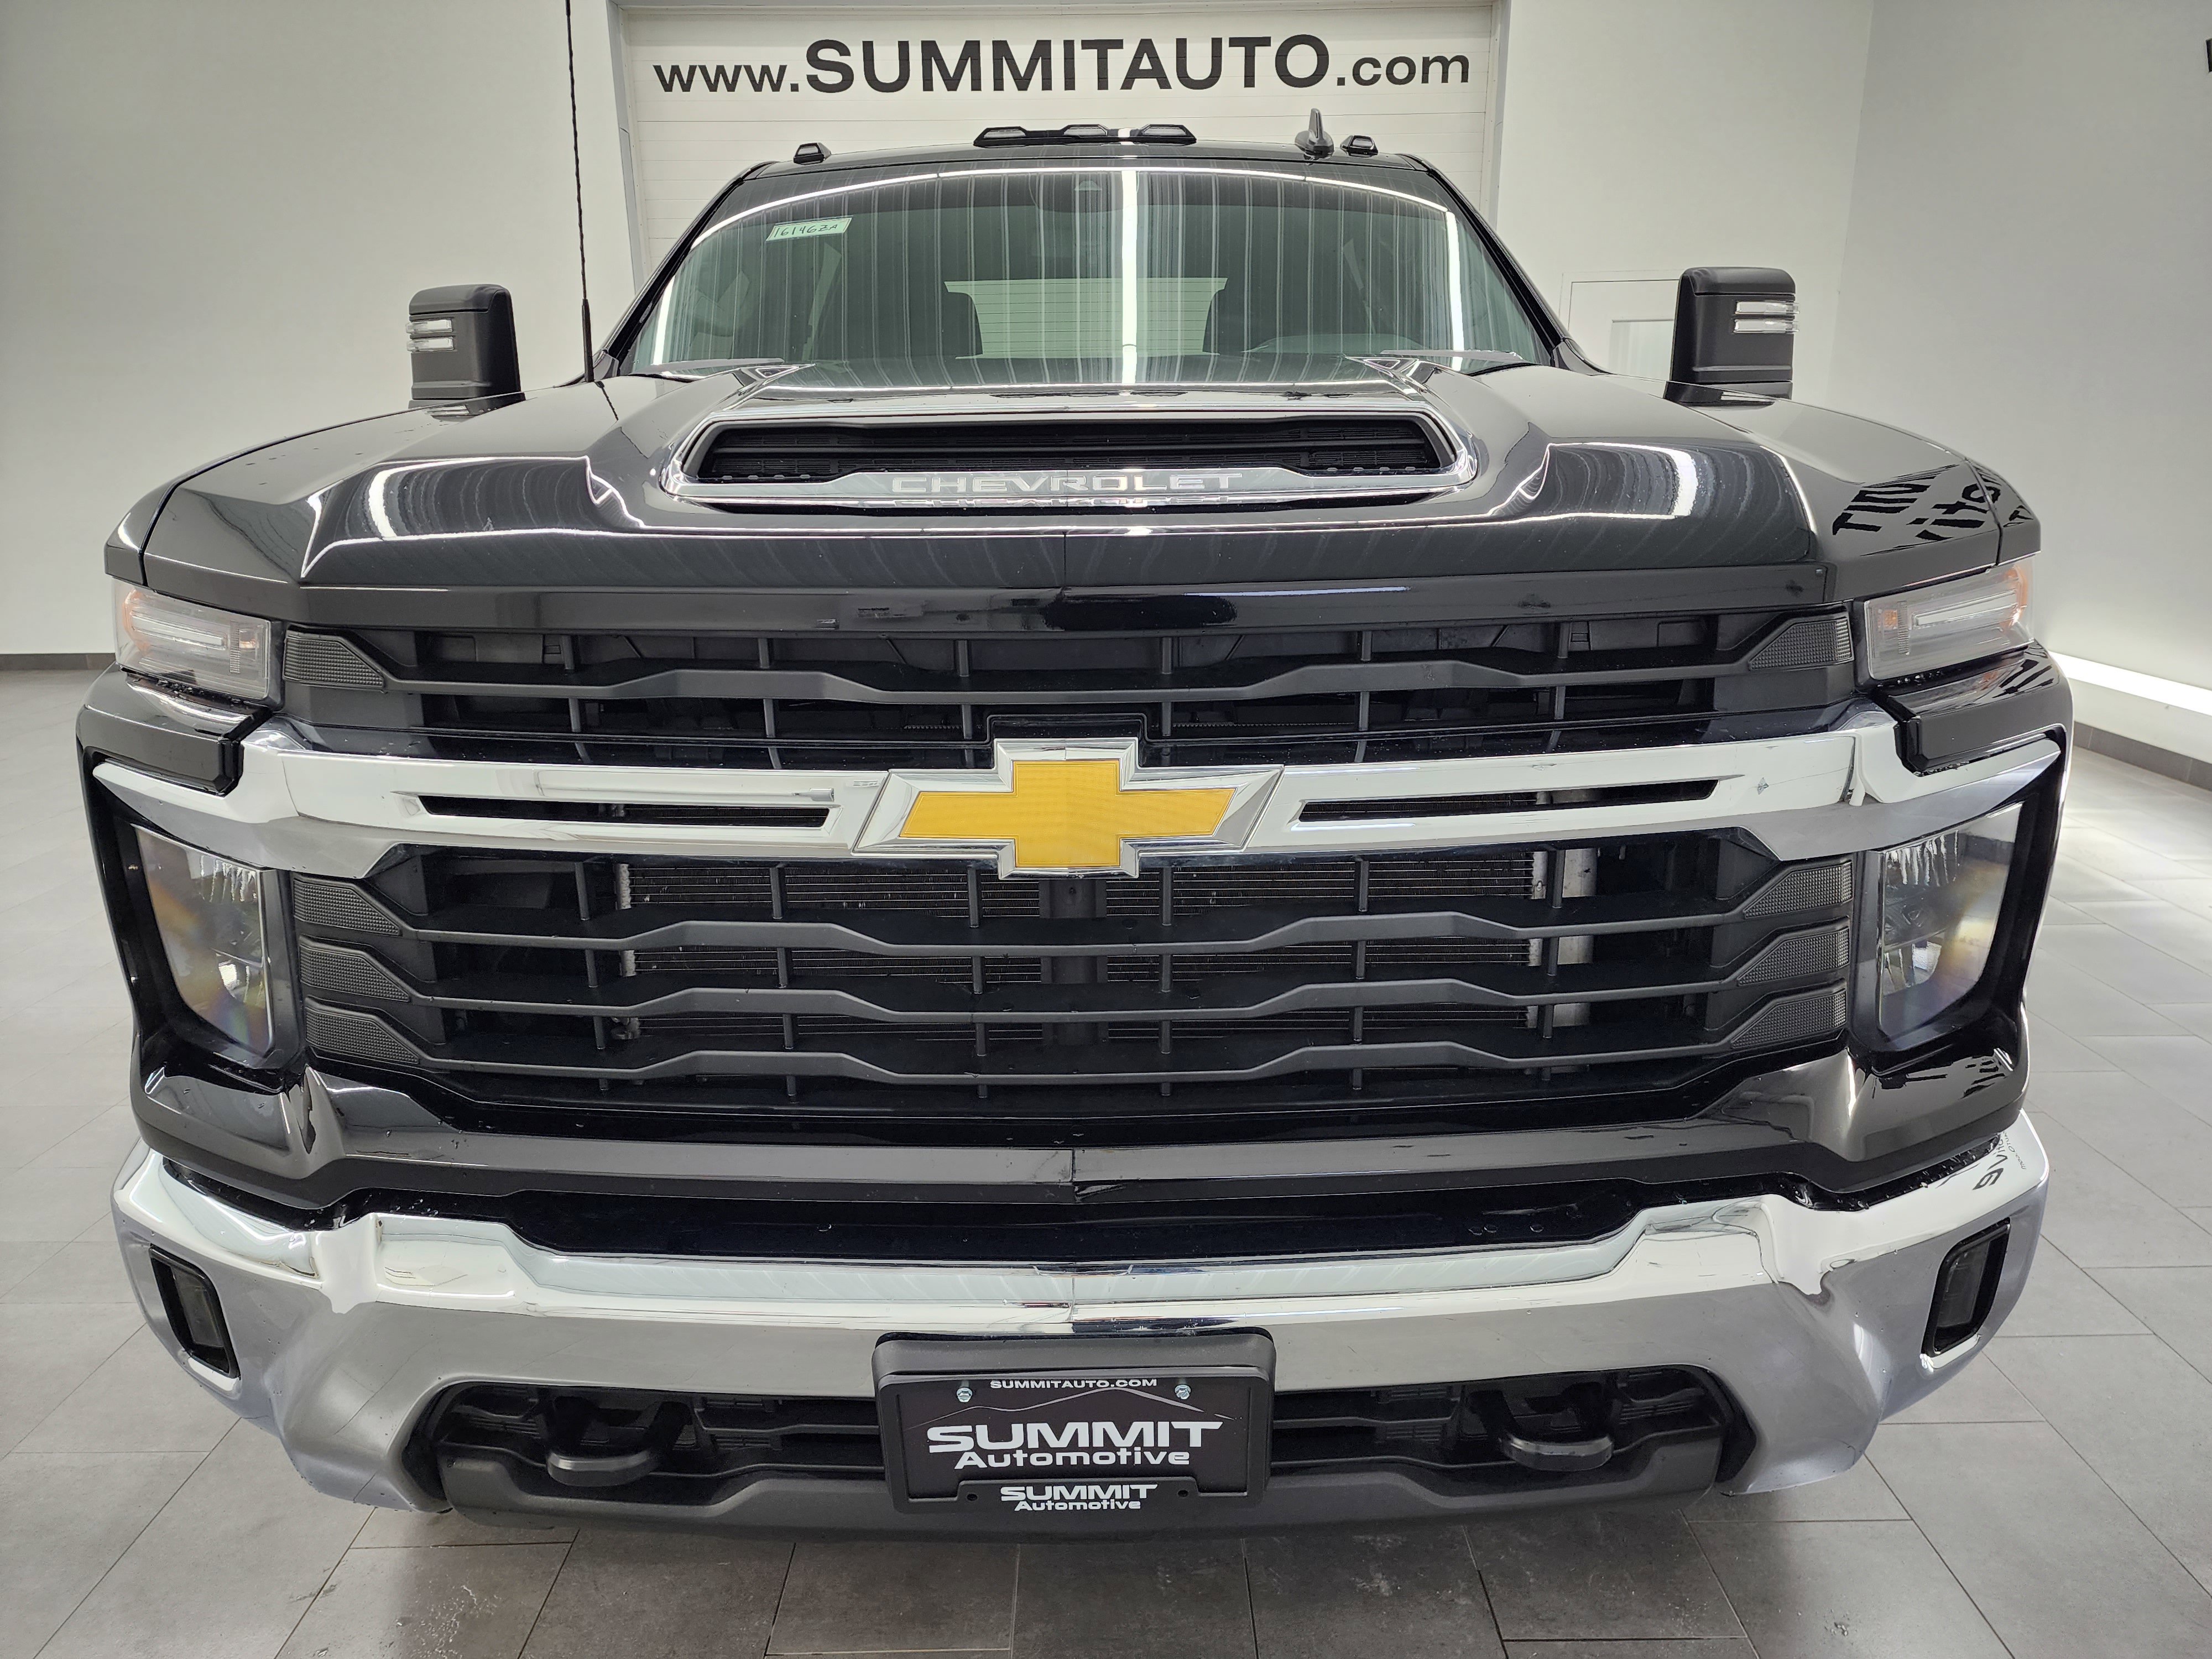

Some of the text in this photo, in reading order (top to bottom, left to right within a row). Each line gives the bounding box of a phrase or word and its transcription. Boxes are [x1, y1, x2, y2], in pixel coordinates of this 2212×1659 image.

[653, 34, 1469, 93] www.SUMMITAUTO.com
[891, 473, 1243, 493] CHEVROLET
[990, 1379, 1157, 1389] SUMMITAUTO.COM
[927, 1421, 1223, 1453] SUMMIT
[954, 1447, 1190, 1470] Automotive
[1000, 1484, 1158, 1501] SUMMIT
[1014, 1499, 1141, 1512] Automotive
